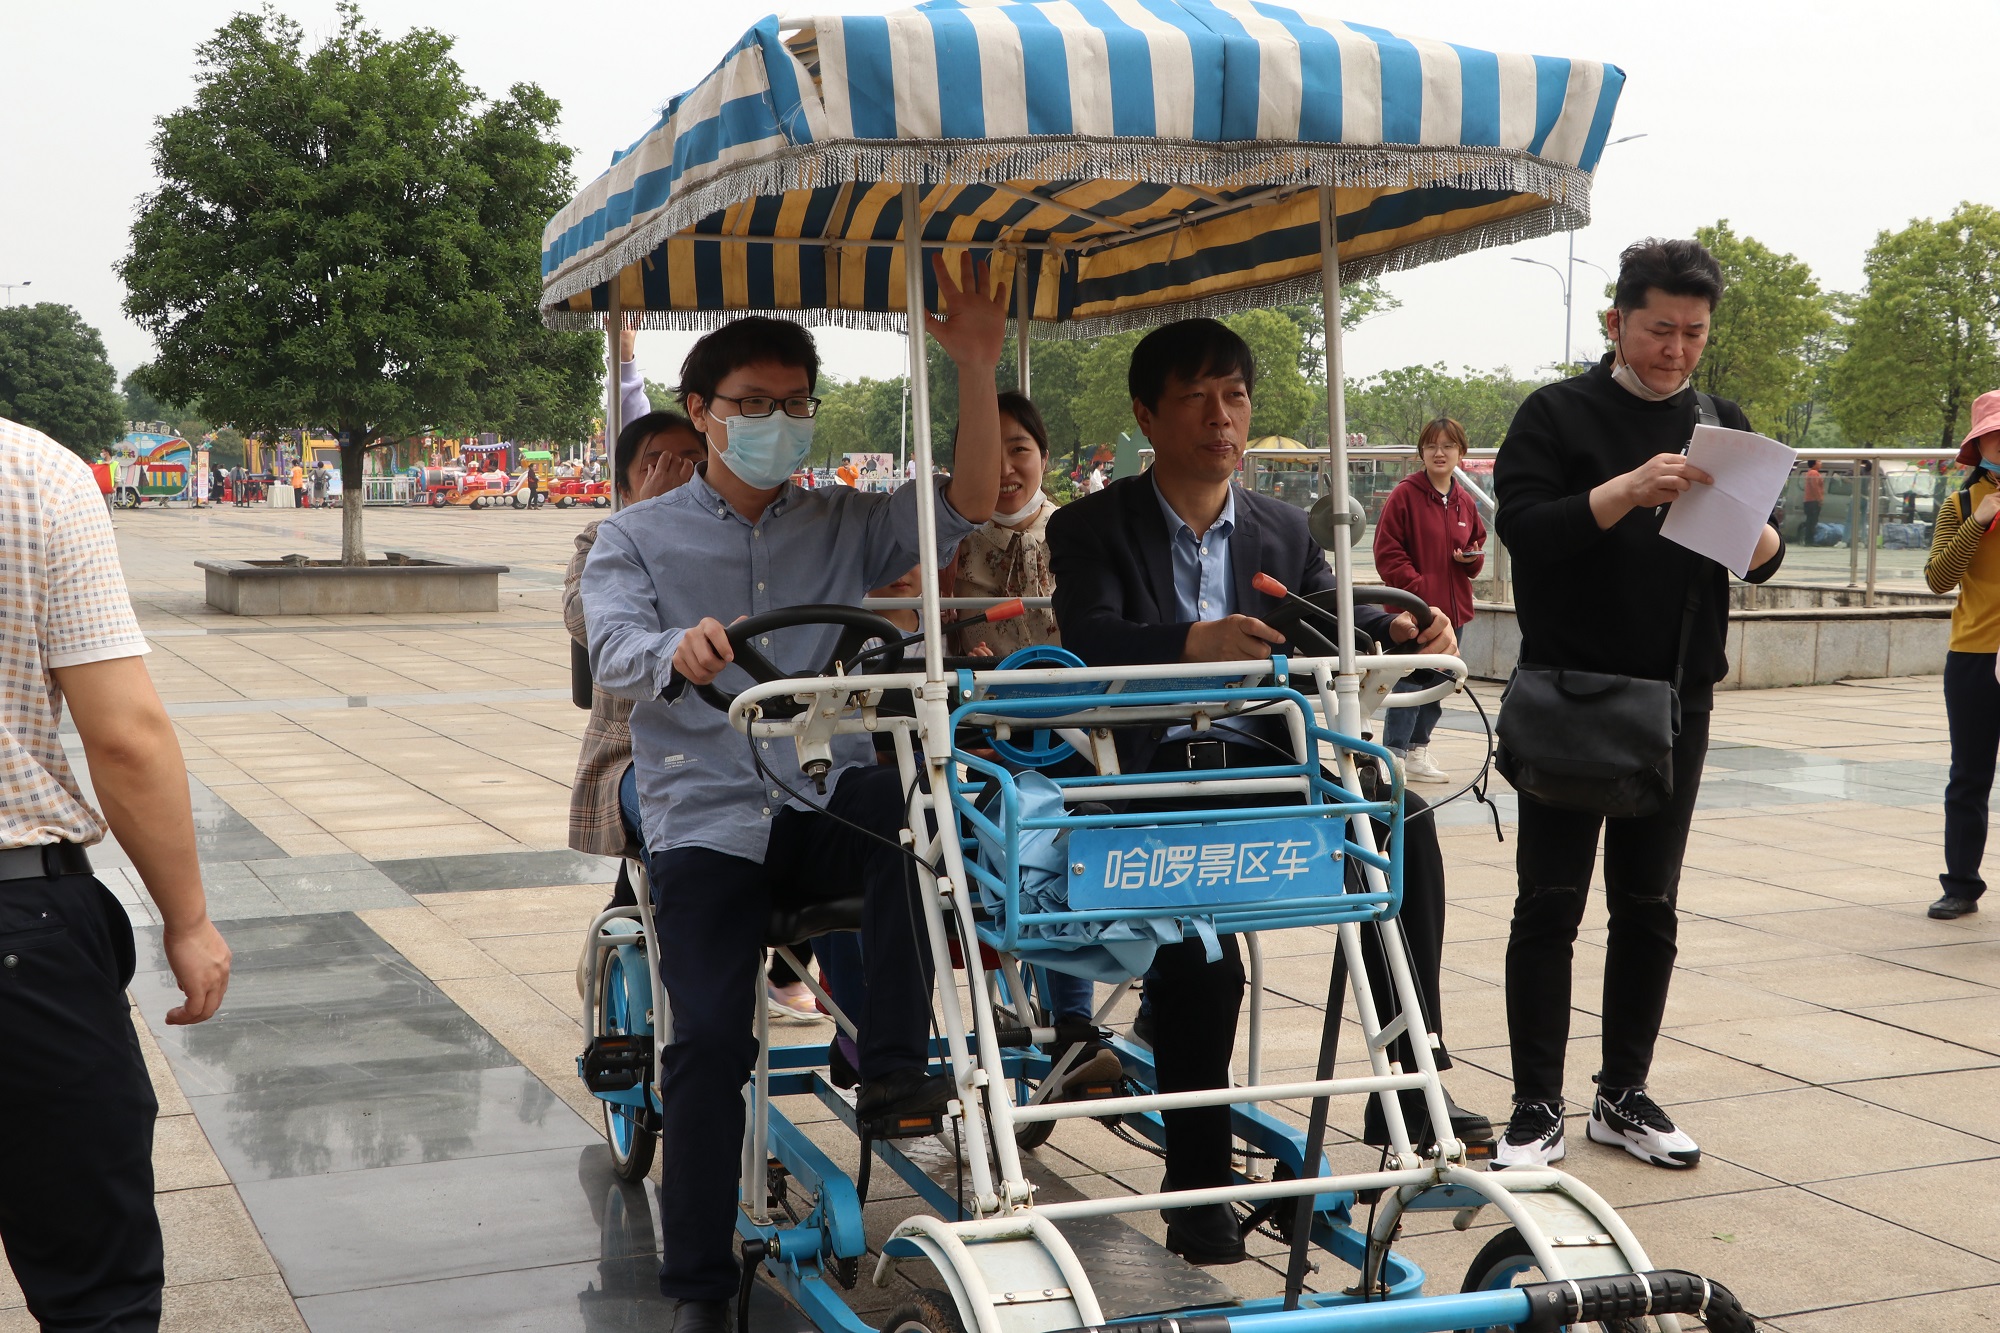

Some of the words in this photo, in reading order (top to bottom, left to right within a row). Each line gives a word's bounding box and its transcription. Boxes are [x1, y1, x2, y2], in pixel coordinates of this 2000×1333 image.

[1104, 839, 1311, 889] 哈啰景区车
